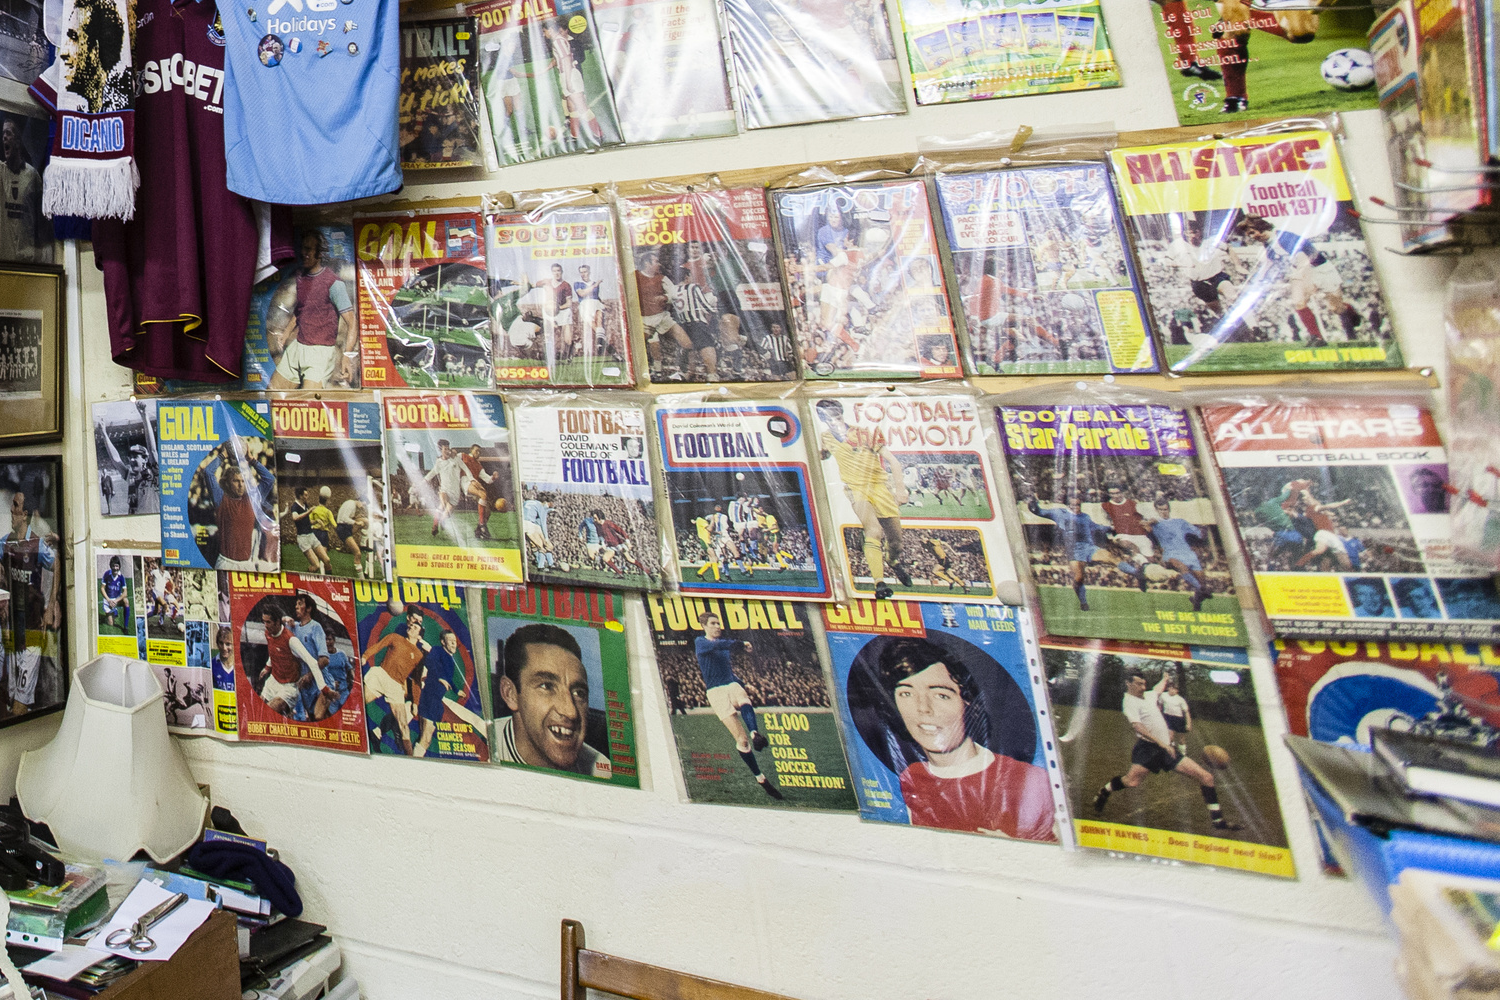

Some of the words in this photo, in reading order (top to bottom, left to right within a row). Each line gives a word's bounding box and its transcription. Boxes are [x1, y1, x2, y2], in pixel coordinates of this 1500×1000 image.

[266, 15, 337, 36] Holidays
[61, 114, 126, 152] DICANIO
[1249, 179, 1317, 201] football
[357, 220, 444, 263] GOAL
[497, 223, 609, 245] SOCCER
[272, 406, 346, 436] FOOTBALL
[387, 402, 470, 426] FOOTBALL
[1002, 408, 1146, 425] FOOTBALL
[158, 407, 220, 441] GOAL
[559, 434, 590, 443] DAVID
[673, 431, 769, 460] FOOTBALL
[1006, 423, 1058, 451] Star
[1064, 422, 1151, 450] Parade
[559, 442, 619, 451] COLEMAN'S
[561, 450, 593, 458] WORLD
[595, 451, 613, 459] OF
[1276, 451, 1373, 464] FOOTBALL
[1375, 449, 1431, 461] BOOK
[561, 458, 649, 486] FOOTBALL
[1155, 610, 1174, 622] THE
[1175, 612, 1192, 624] BIG
[1193, 613, 1235, 625] NAMES
[1142, 623, 1164, 633] THE
[1165, 624, 1192, 635] BEST
[1192, 625, 1238, 638] PICTURES
[763, 712, 810, 733] £1,000
[247, 722, 267, 735] BOBBY
[268, 725, 298, 737] CHARLTON
[309, 729, 327, 739] LEEDS
[327, 730, 339, 740] and
[340, 731, 361, 743] CELTIC
[436, 732, 463, 743] CHANCES
[767, 733, 791, 746] FOR
[438, 741, 453, 751] THIS
[453, 743, 476, 753] SEASON
[771, 746, 809, 761] GOALS
[774, 760, 817, 775] SOCCER
[778, 774, 846, 790] SENSATION!
